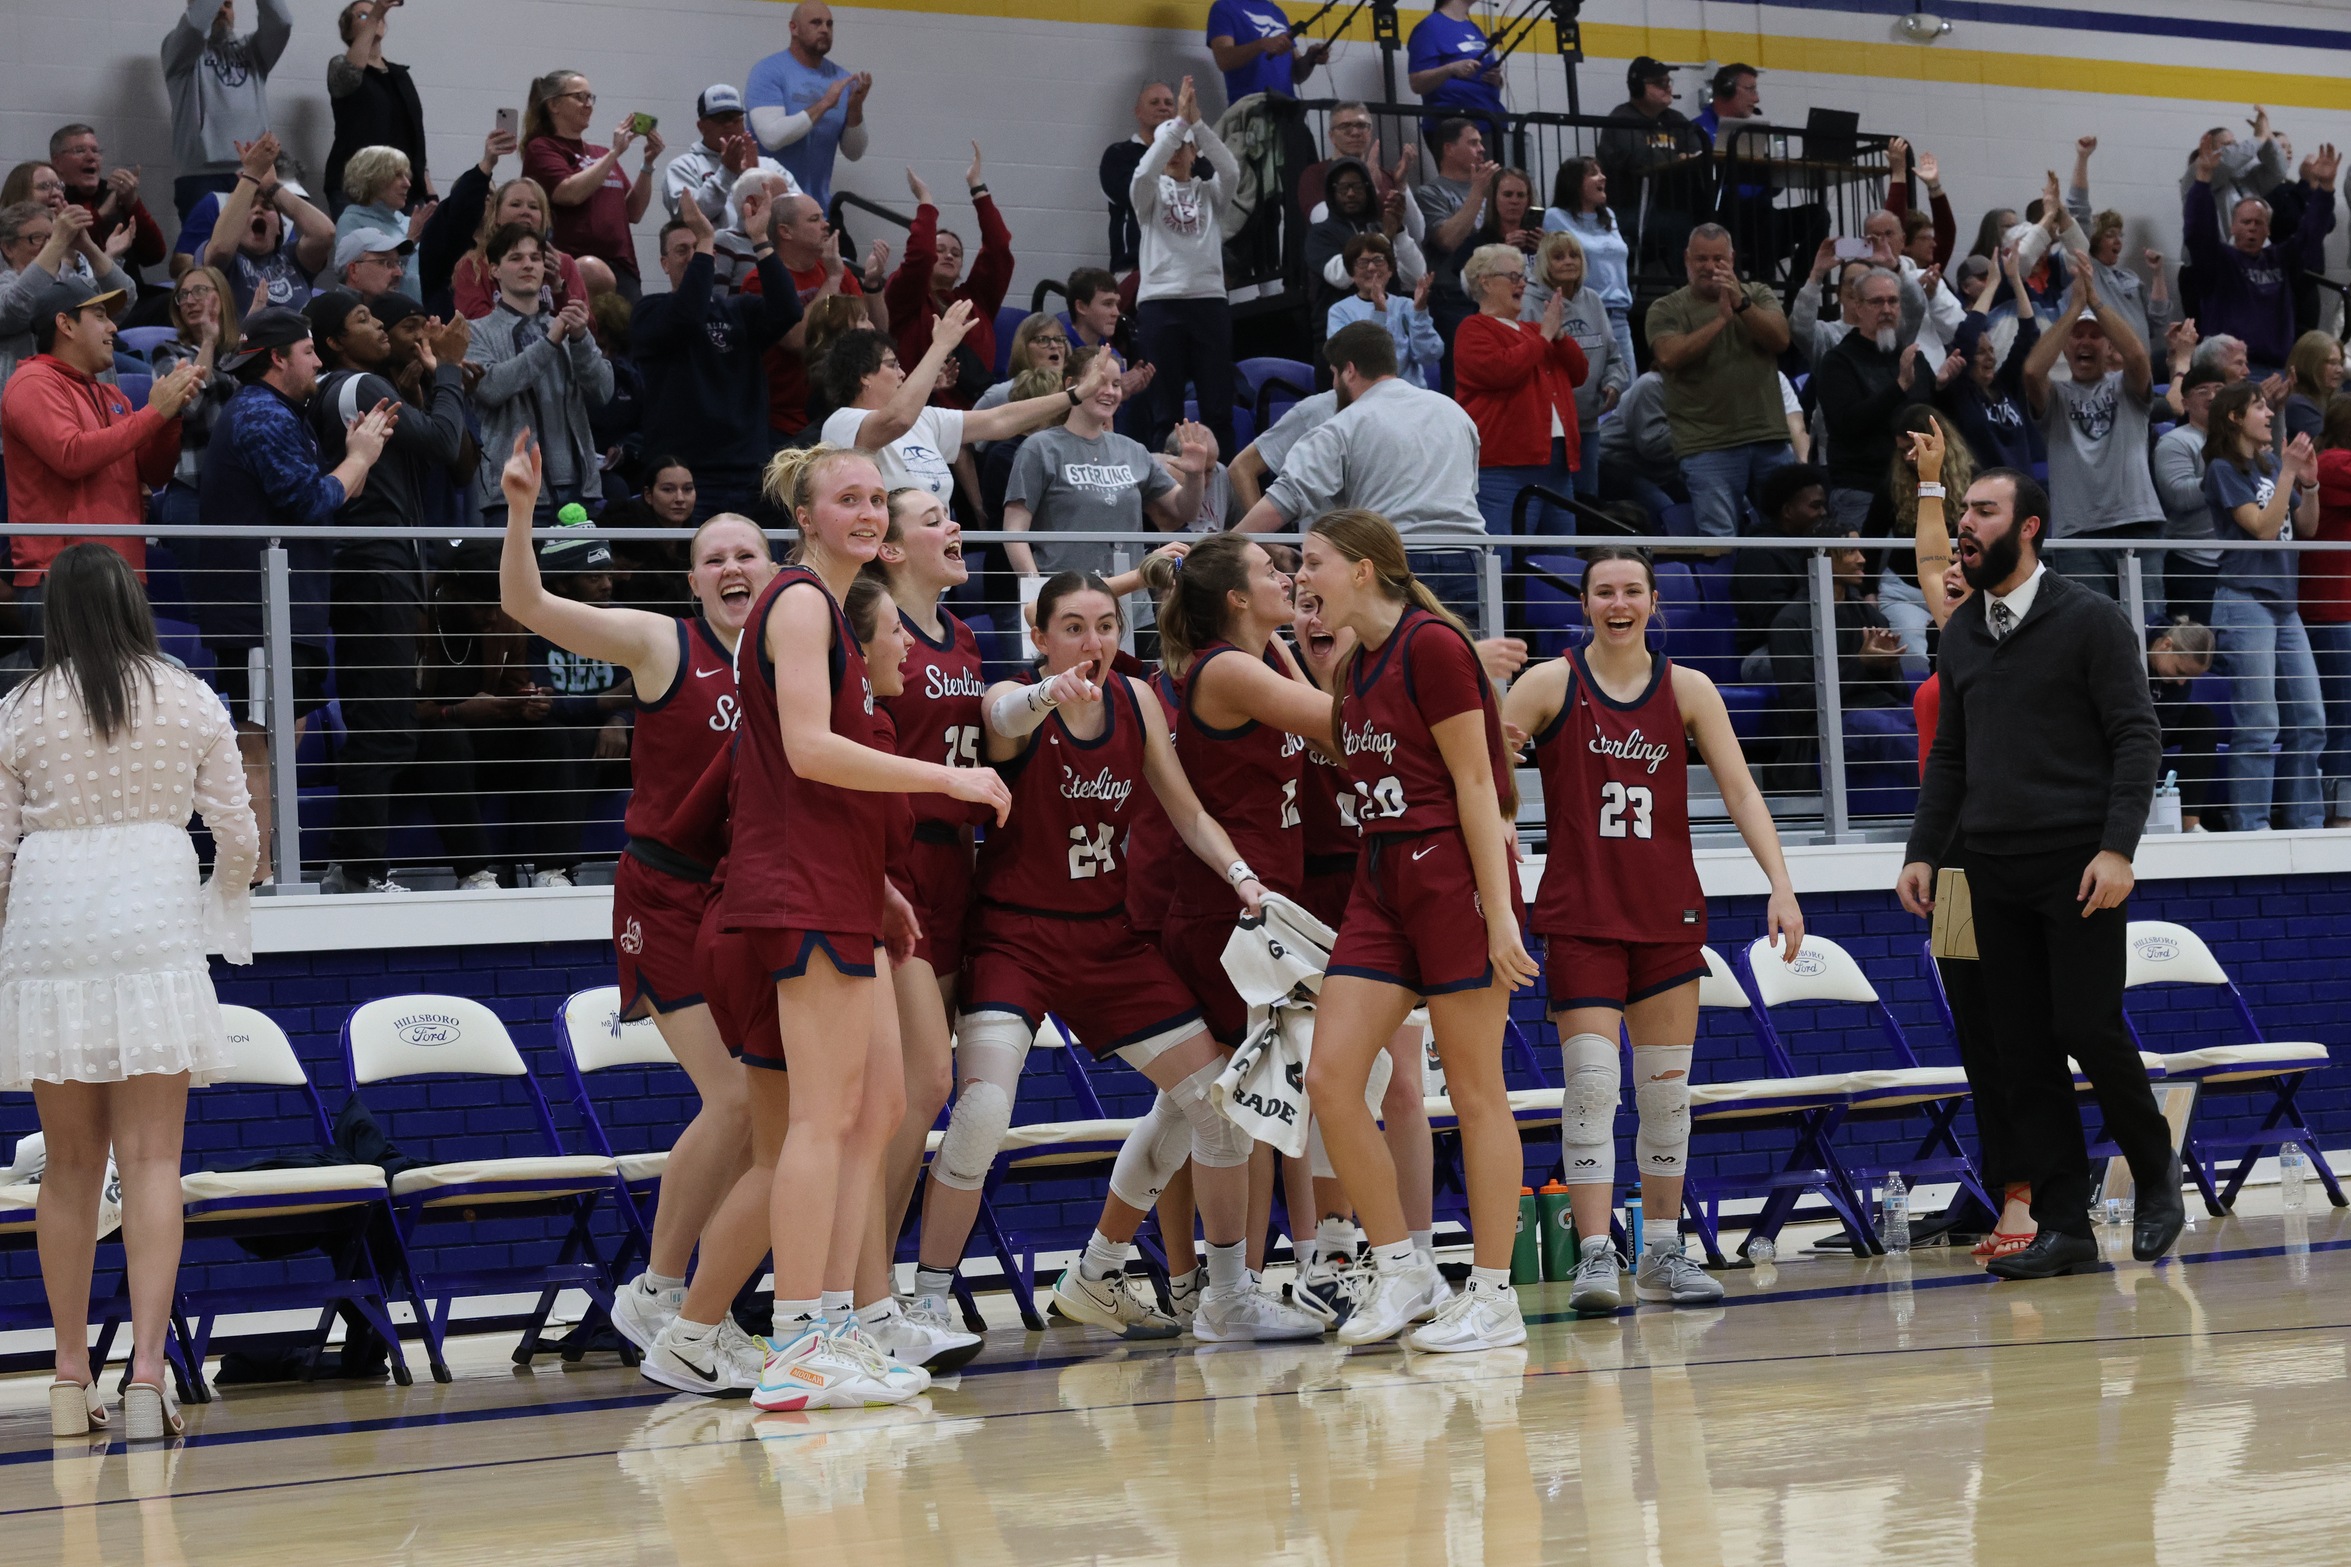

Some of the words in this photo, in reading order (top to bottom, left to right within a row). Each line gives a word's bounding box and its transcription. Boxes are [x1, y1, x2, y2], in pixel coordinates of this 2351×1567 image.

[1069, 466, 1132, 485] STERLING
[944, 725, 981, 769] 25
[1060, 765, 1132, 812] Sterling
[1599, 781, 1653, 839] 23
[1068, 822, 1116, 879] 24
[2133, 936, 2178, 949] HILLSBORO
[2146, 946, 2171, 959] Ford
[1793, 960, 1818, 973] Ford
[393, 1014, 460, 1029] HILLSBORO
[411, 1025, 448, 1042] Ford
[1626, 1209, 1635, 1264] POWERADE
[791, 1367, 824, 1386] MOOLAH
